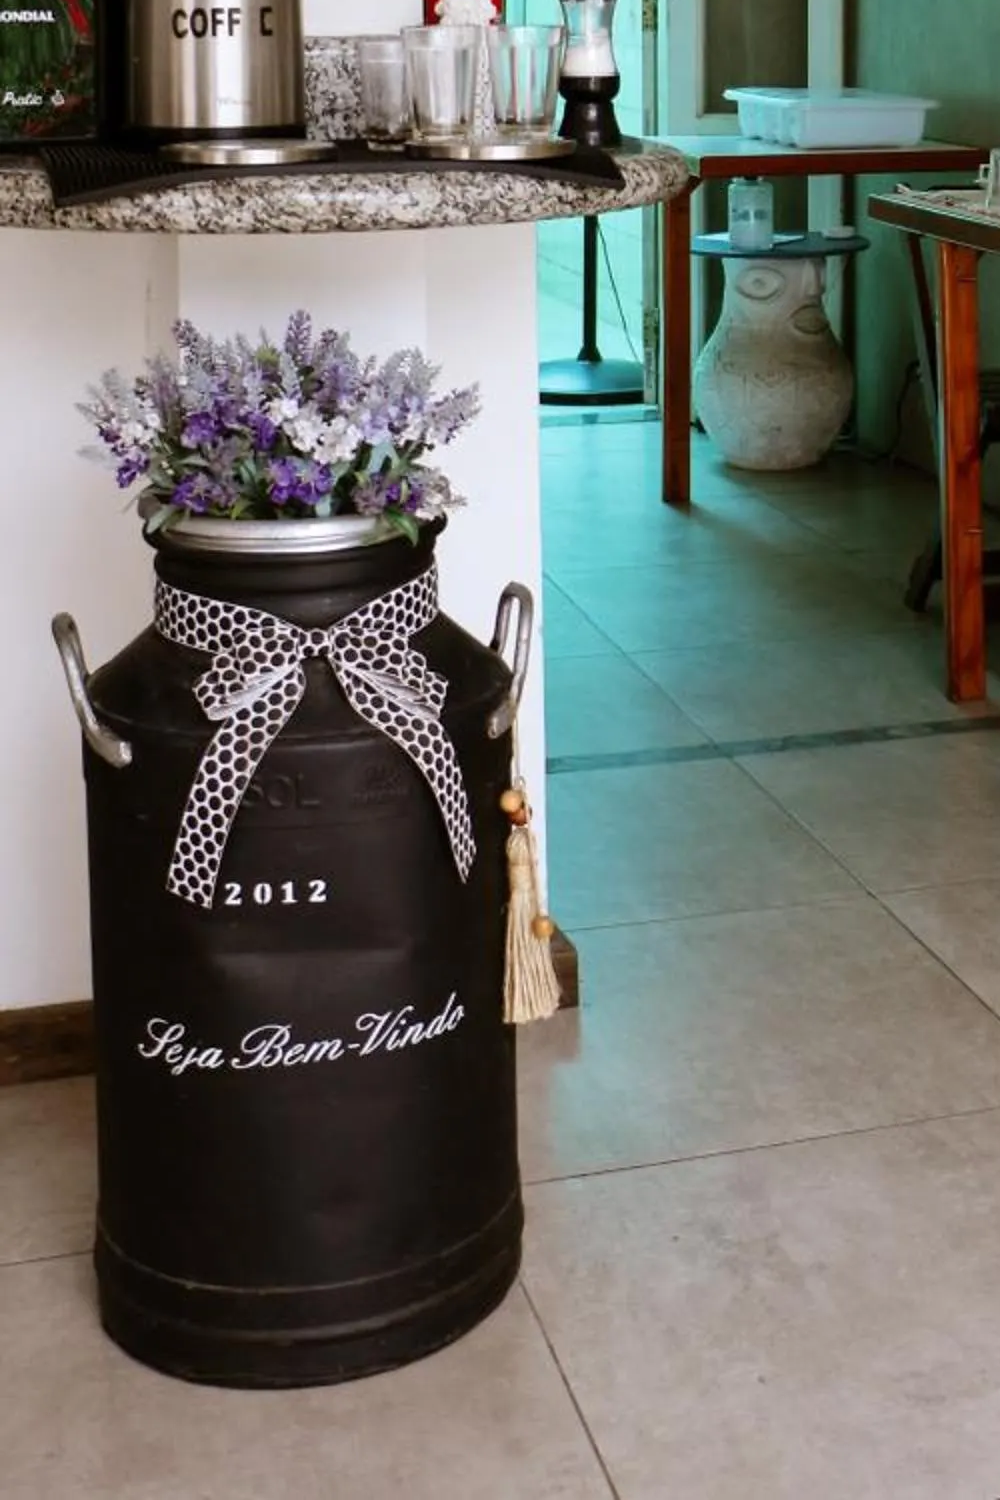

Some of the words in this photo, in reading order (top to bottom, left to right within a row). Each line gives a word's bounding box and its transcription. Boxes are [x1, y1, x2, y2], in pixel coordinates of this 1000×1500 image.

[0, 10, 56, 23] ONDIAL
[225, 879, 327, 906] 2012
[138, 1017, 226, 1076] Seja
